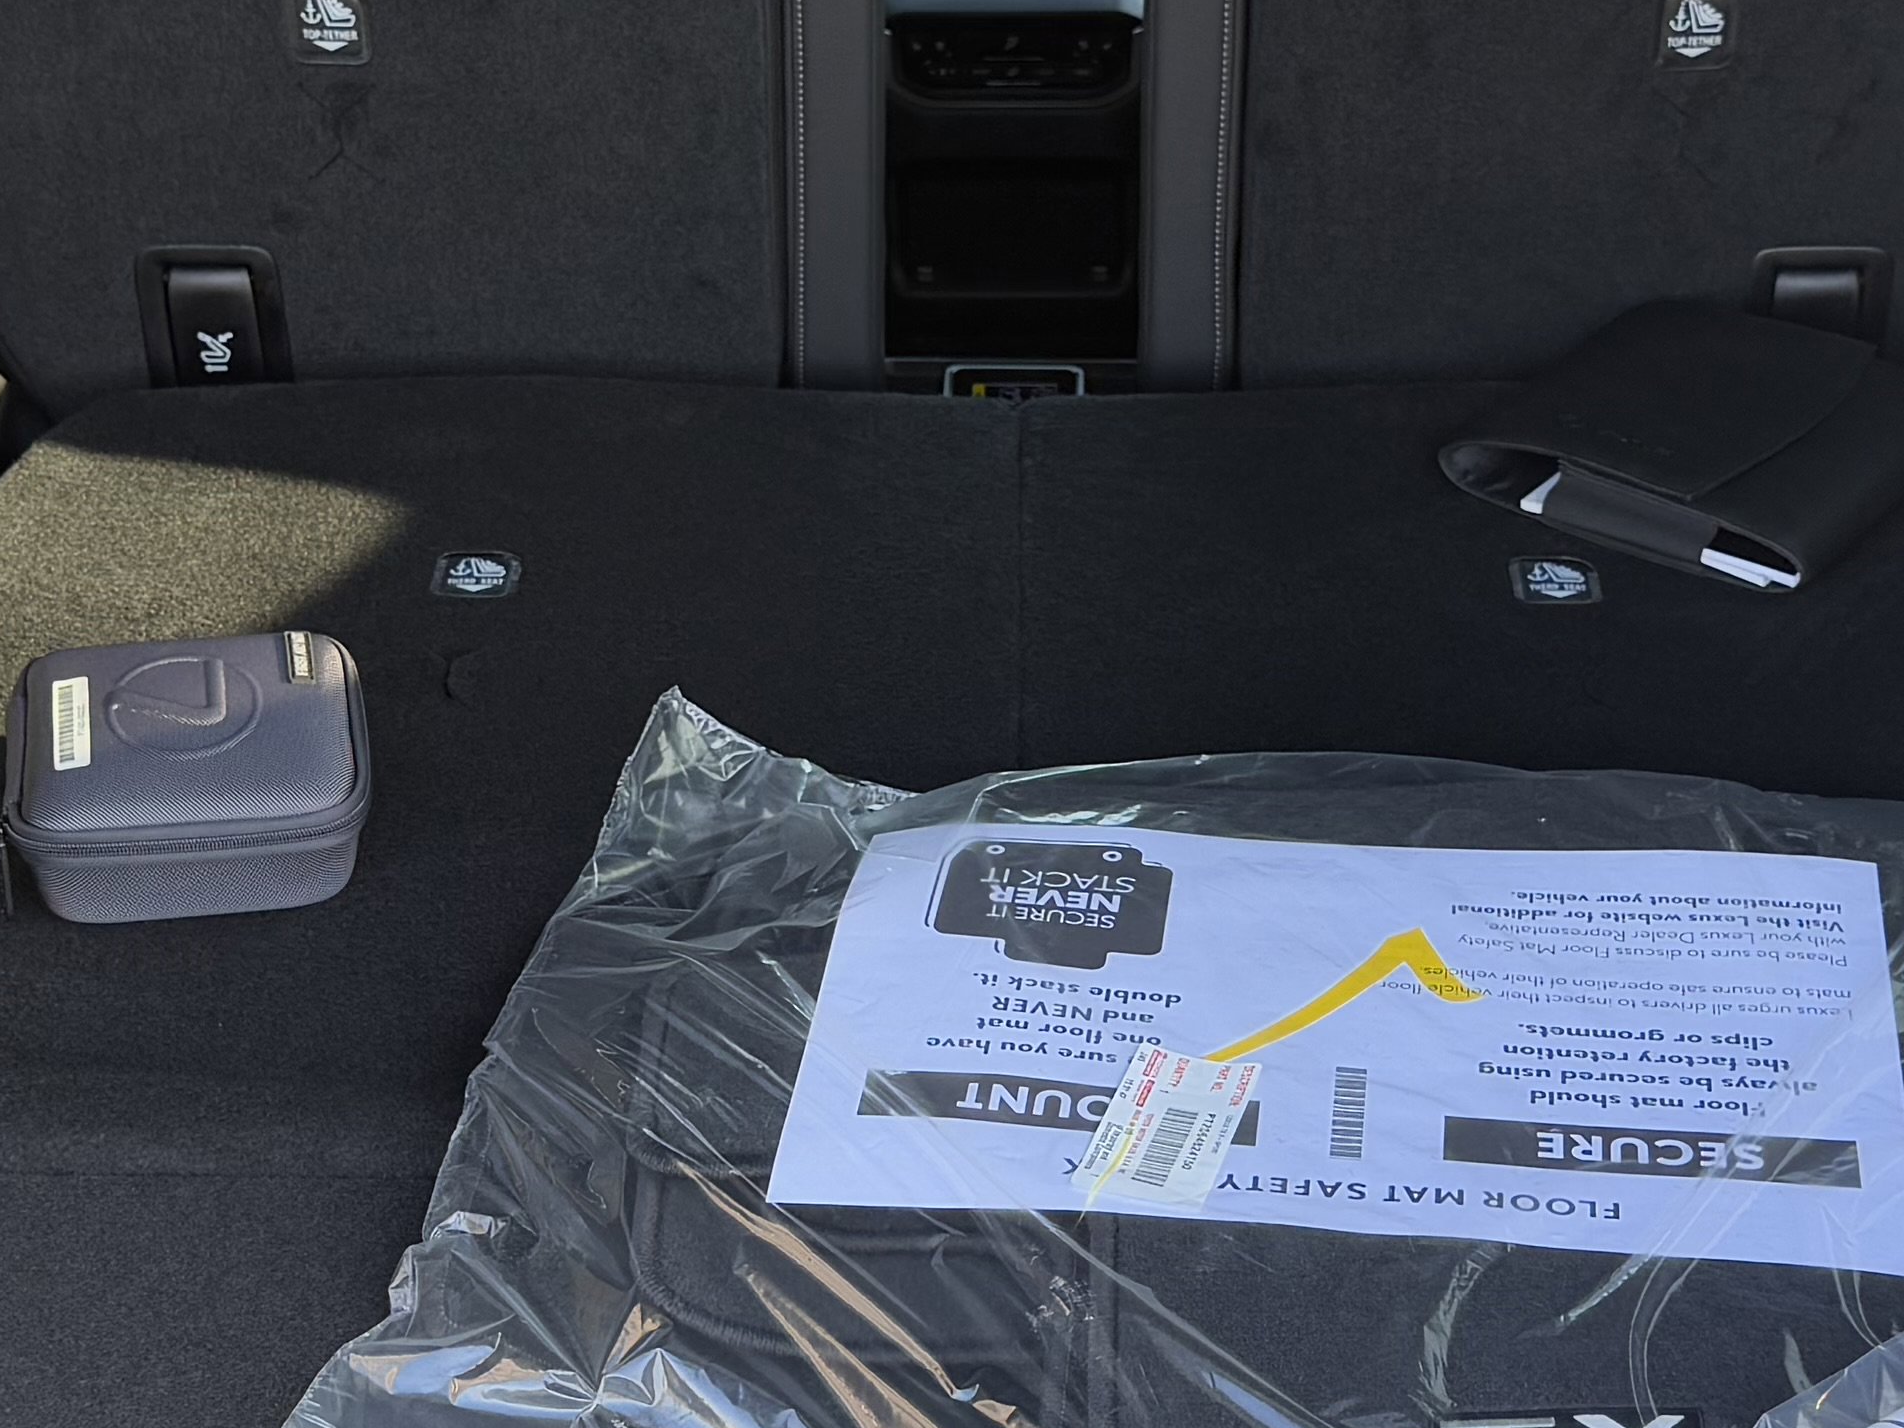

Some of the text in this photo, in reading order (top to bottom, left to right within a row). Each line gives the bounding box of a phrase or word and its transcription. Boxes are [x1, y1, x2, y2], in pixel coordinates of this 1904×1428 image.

[979, 867, 1136, 893] STACK IT
[988, 884, 1121, 913] NEVER
[1510, 891, 1589, 905] vehicle.
[1596, 892, 1642, 905] your
[1649, 896, 1710, 908] about
[985, 904, 1116, 929] SECURE IT
[1450, 904, 1844, 933] Visit the Lexus website for additional
[1632, 930, 1694, 944] Dealer
[1700, 931, 1754, 944] Lexus
[1760, 929, 1802, 944] your
[1807, 935, 1845, 948] with
[1457, 934, 1847, 967] Please be sure to discuss Floor Mat Safety
[1378, 980, 1421, 995] floor
[1502, 973, 1544, 987] their
[1550, 977, 1567, 989] of
[1572, 979, 1663, 993] operation
[972, 972, 1182, 1008] double stack it.
[1427, 983, 1492, 997] vehicle
[1496, 990, 1539, 1004] their
[1668, 983, 1707, 996] safe
[1712, 984, 1776, 996] ensure
[1782, 987, 1800, 998] to
[1806, 988, 1851, 1000] mats
[1544, 991, 1612, 1008] inspect
[1617, 998, 1635, 1009] to
[1641, 999, 1706, 1014] drivers
[991, 995, 1154, 1024] and NEVER
[1712, 1003, 1733, 1015] all
[1737, 1001, 1792, 1015] urges
[976, 1017, 1162, 1046] one floor mat
[1517, 1023, 1773, 1051] clips or grommets.
[925, 1036, 990, 1055] have
[1000, 1039, 1048, 1059] you
[1058, 1047, 1117, 1065] sure
[1502, 1044, 1790, 1073] the factory retention
[1477, 1061, 1551, 1081] using
[1559, 1069, 1670, 1085] secured
[1679, 1075, 1712, 1092] be
[956, 1082, 1112, 1122] OUNT
[1529, 1090, 1621, 1109] should
[1629, 1095, 1684, 1109] mat
[1535, 1131, 1765, 1170] SECURE
[1216, 1173, 1620, 1221] FLOOR MAT SAFETY
